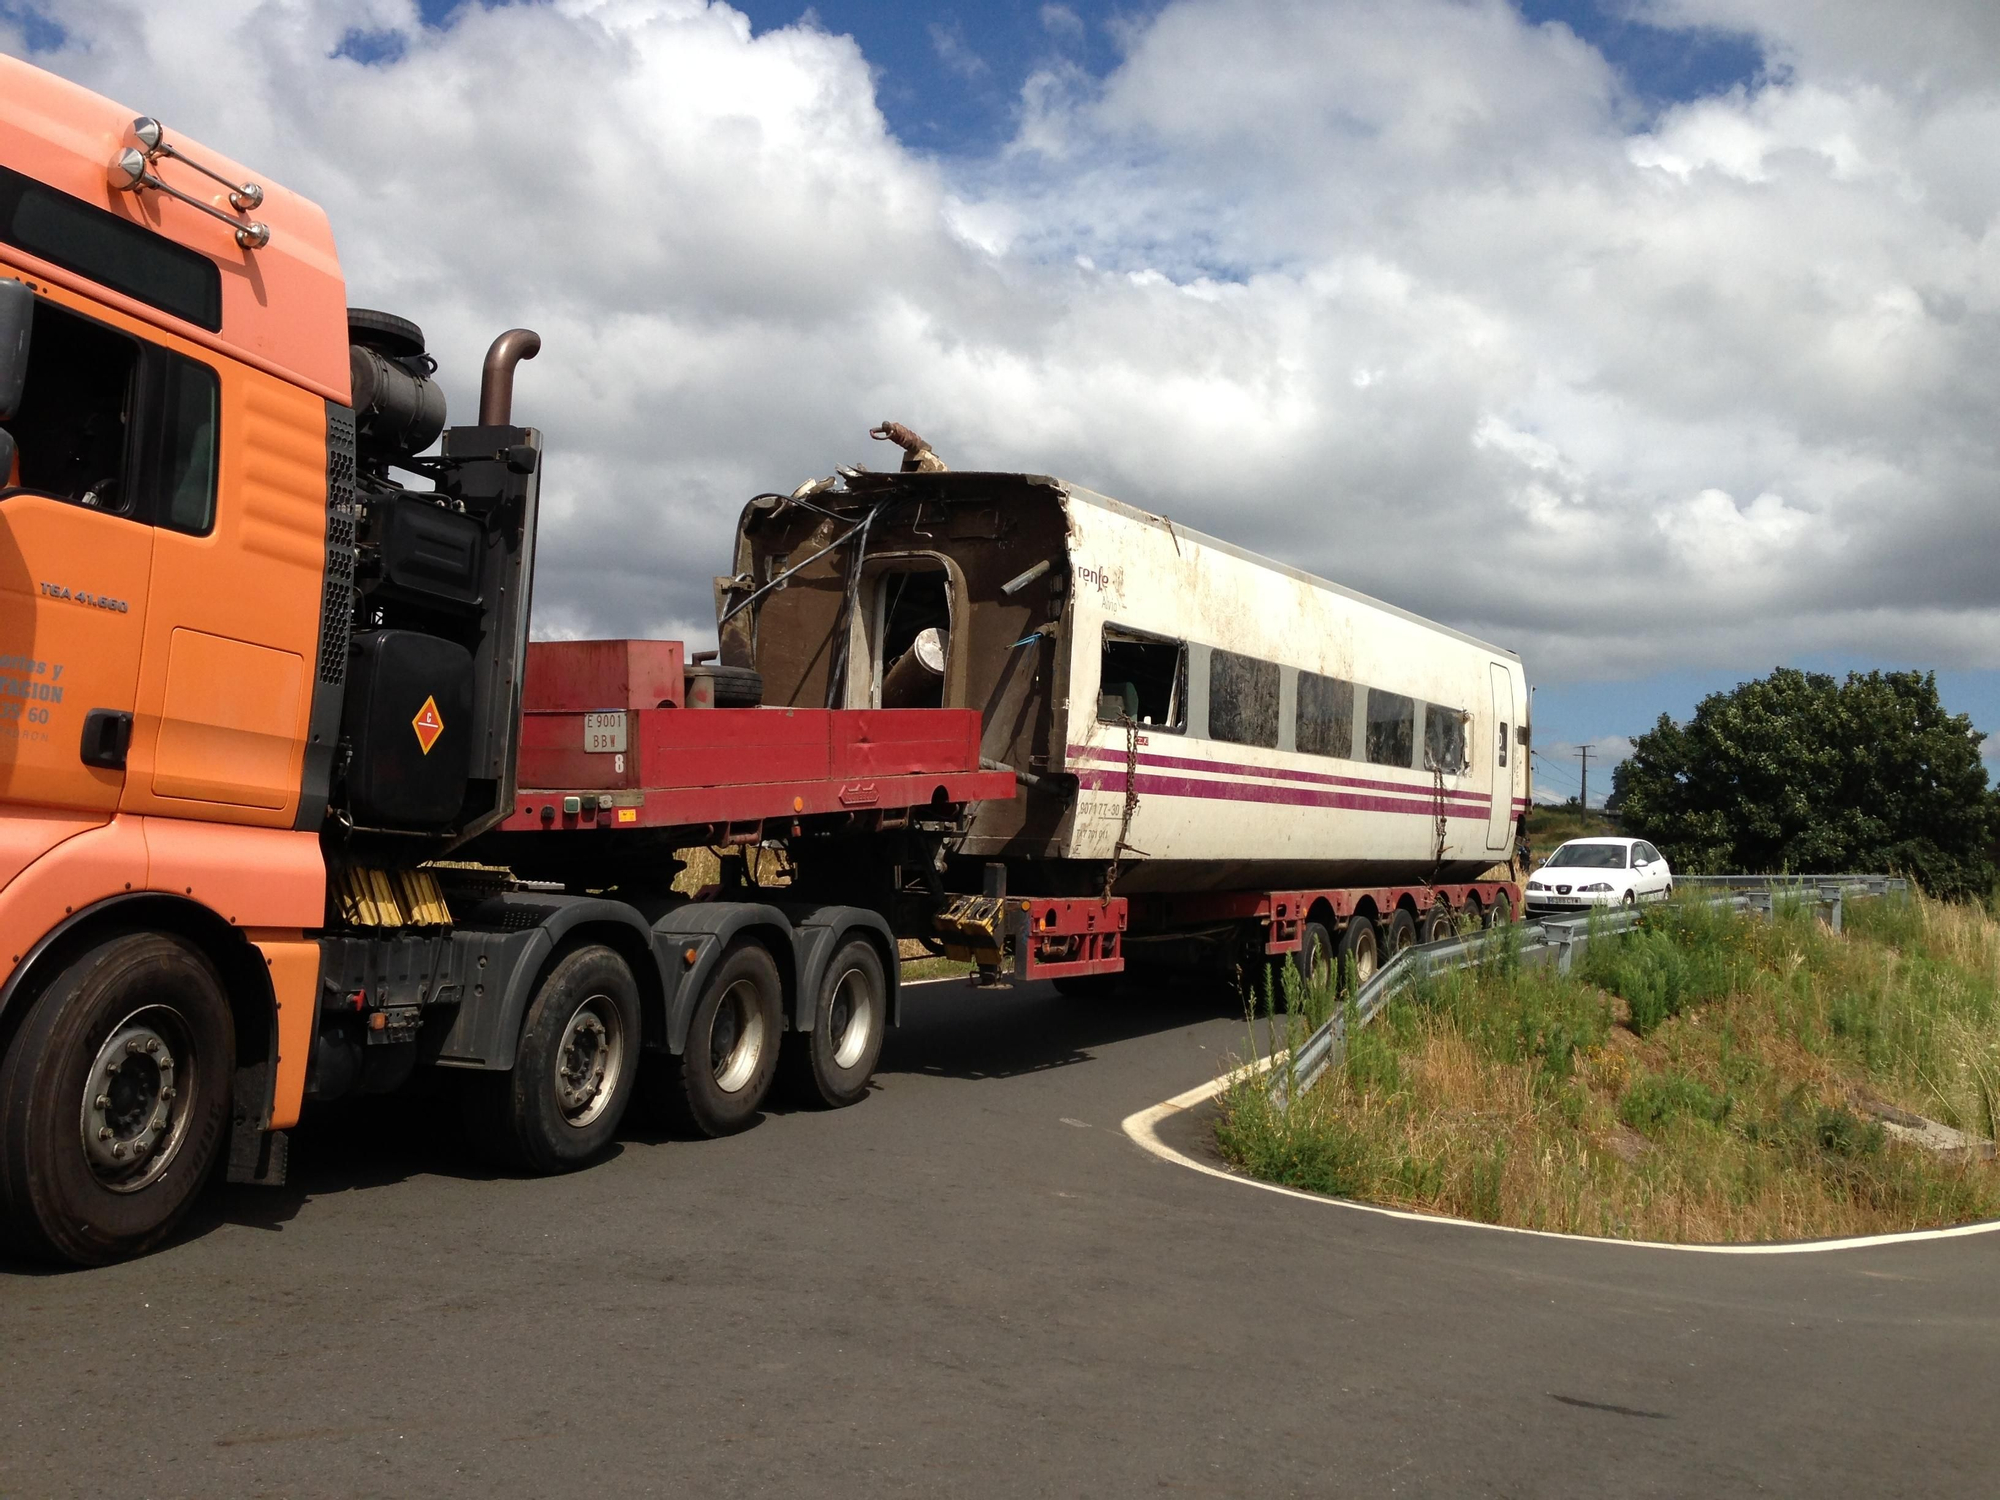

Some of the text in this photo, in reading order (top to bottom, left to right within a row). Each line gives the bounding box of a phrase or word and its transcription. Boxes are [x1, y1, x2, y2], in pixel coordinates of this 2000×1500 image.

[1078, 566, 1109, 592] renfe
[40, 581, 129, 614] TGA 41.660
[51, 664, 64, 681] y
[28, 706, 49, 725] 60
[587, 714, 622, 728] E 9001
[593, 734, 616, 748] BBW
[615, 754, 624, 773] 8
